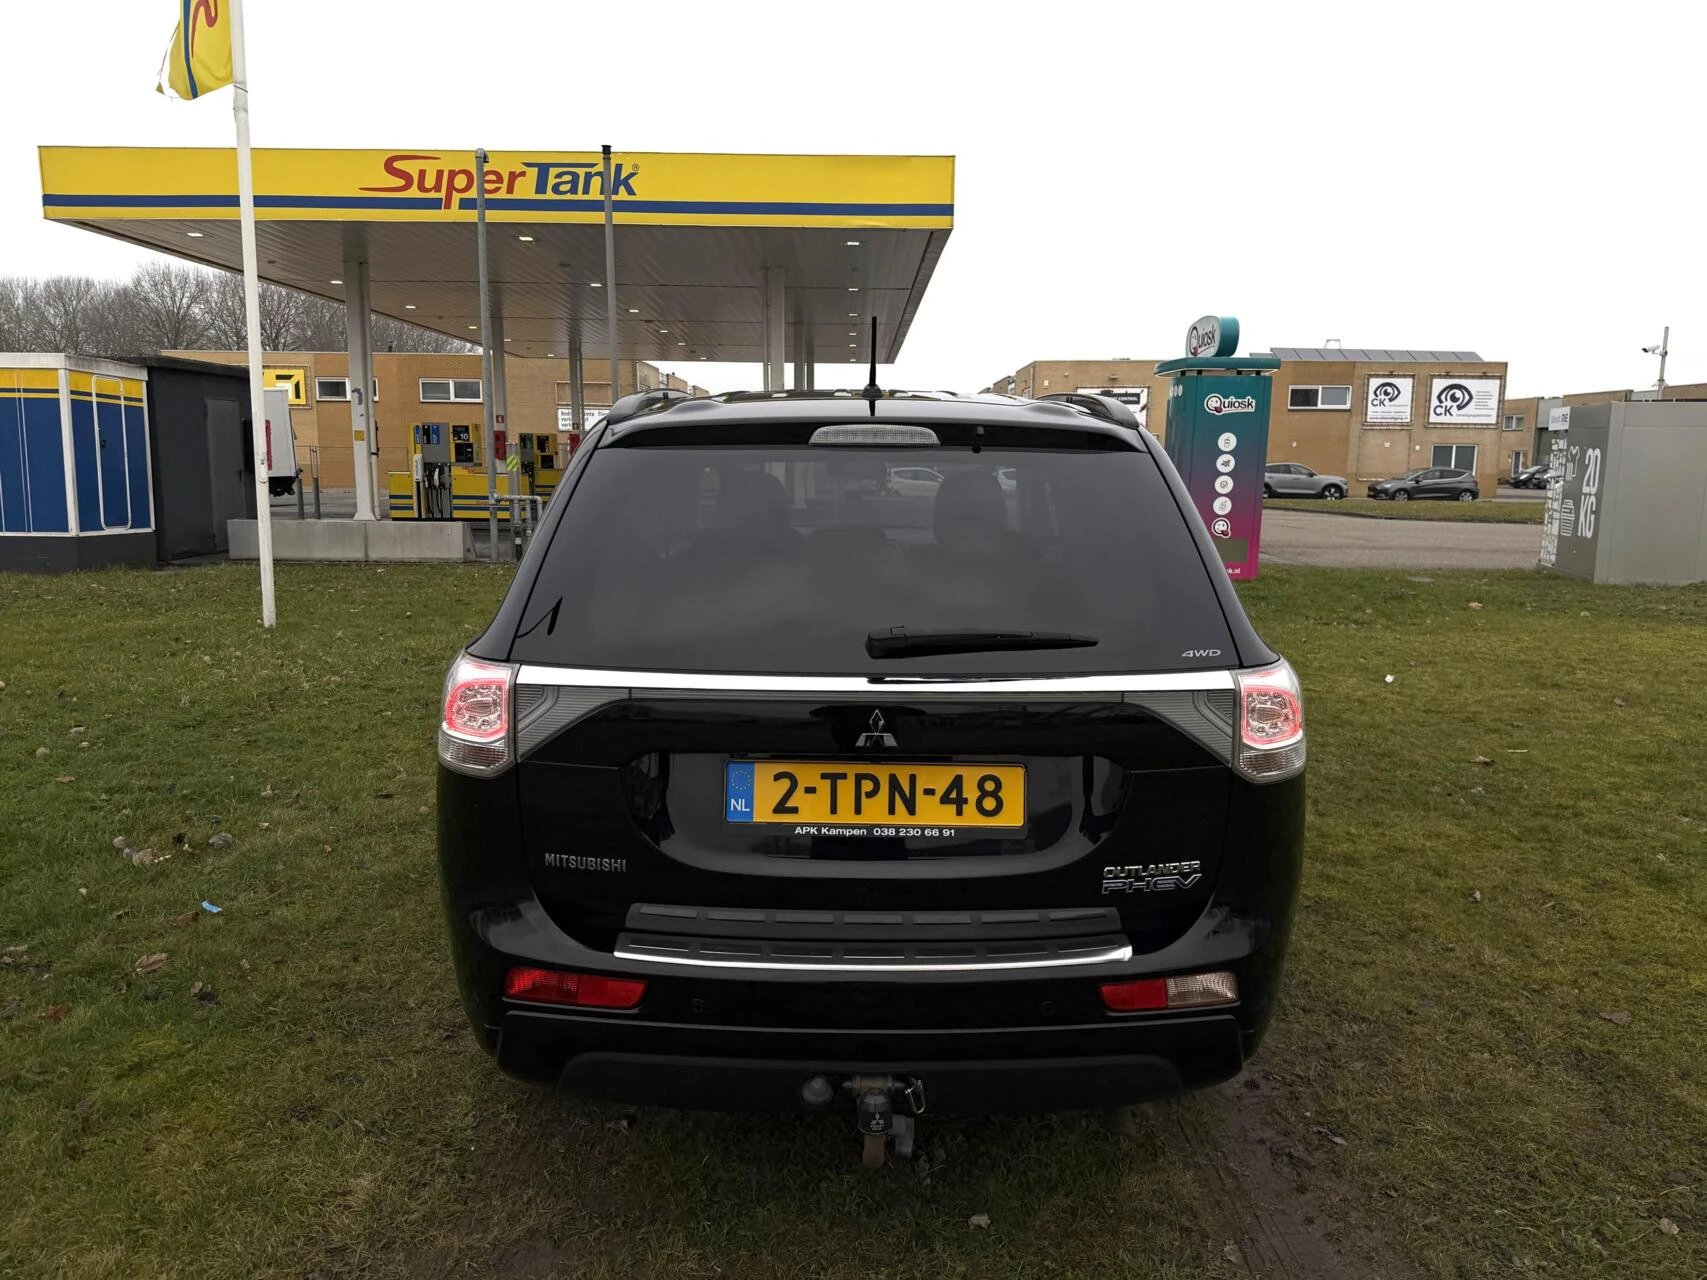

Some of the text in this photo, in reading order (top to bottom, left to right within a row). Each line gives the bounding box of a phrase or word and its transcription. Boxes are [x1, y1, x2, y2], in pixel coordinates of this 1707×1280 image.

[1190, 325, 1216, 356] Quiosk
[1206, 395, 1254, 413] Quiosk
[1371, 398, 1386, 407] CK
[1433, 405, 1453, 416] CK
[1582, 448, 1601, 495] 20
[1578, 494, 1596, 539] KG
[1181, 649, 1221, 657] 4WD
[772, 771, 1004, 817] 2-TPN-48
[730, 798, 750, 812] NL
[794, 826, 955, 837] APK Kampen 038 230 66 91
[544, 852, 627, 873] MITSUBISHI
[1103, 860, 1201, 878] OUTLANDER
[1102, 873, 1202, 895] PHEV
